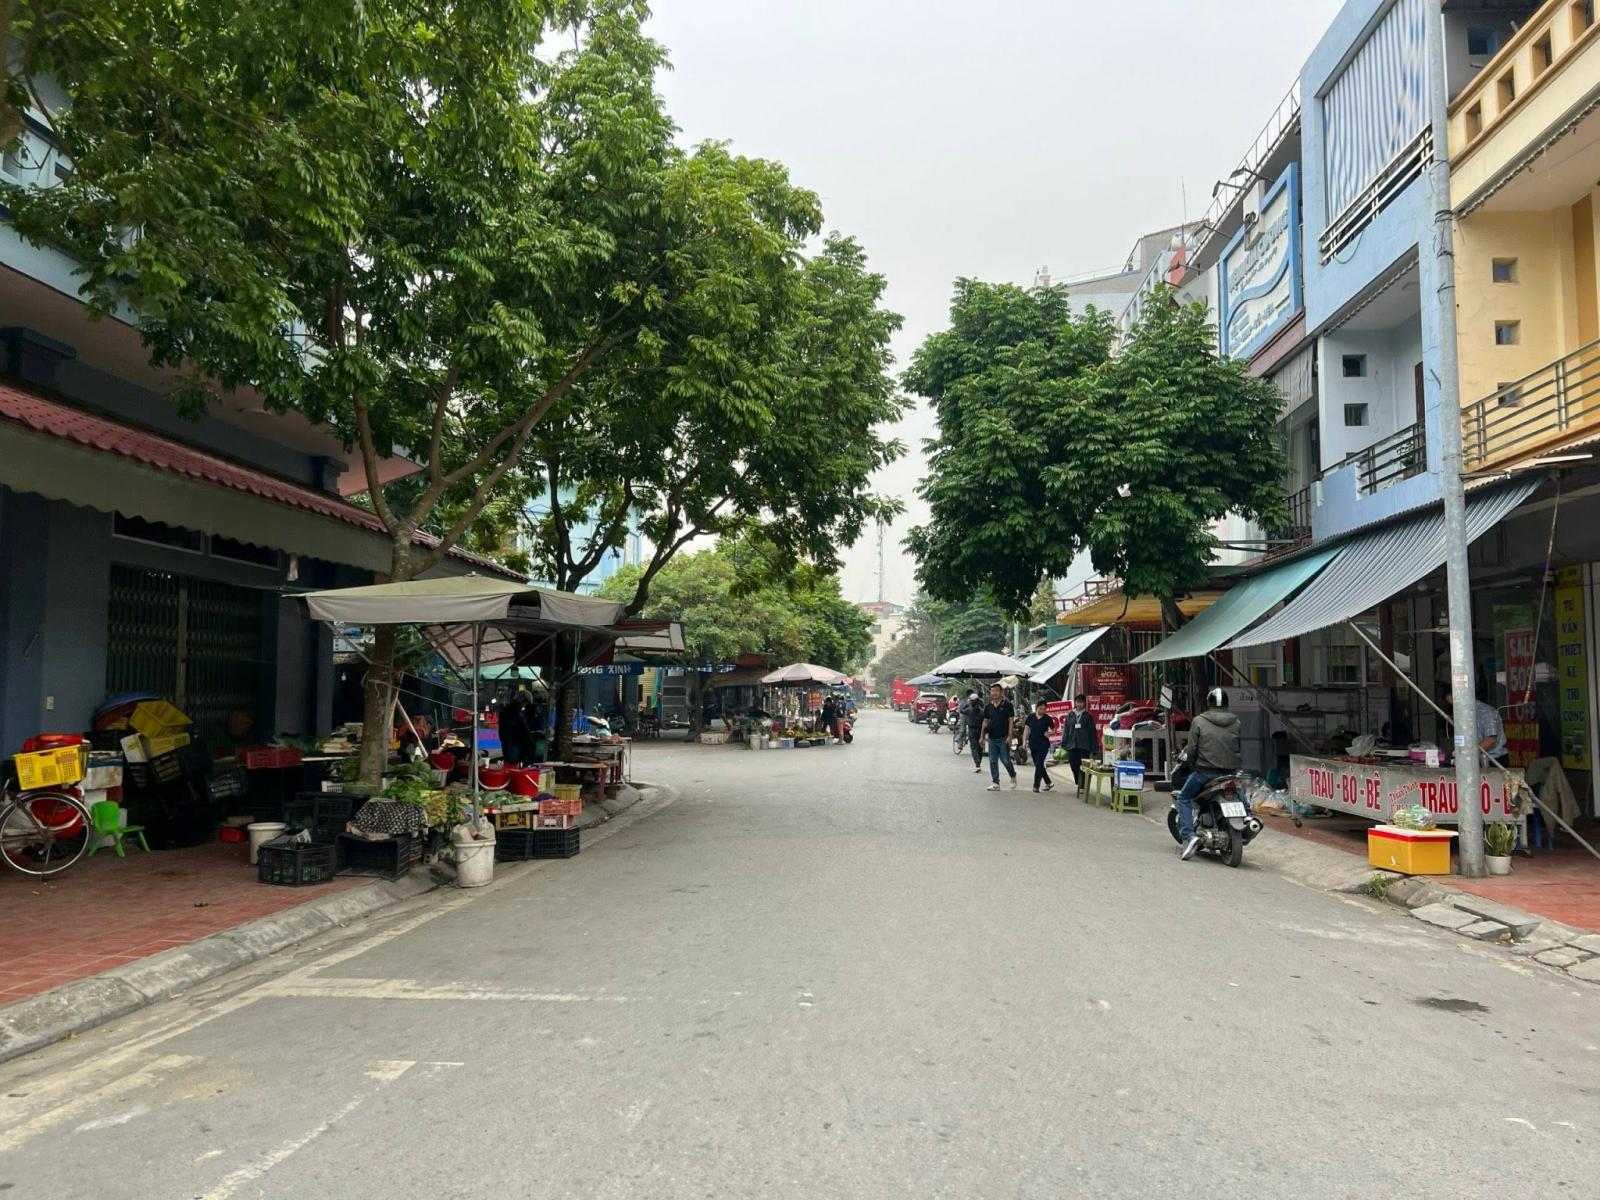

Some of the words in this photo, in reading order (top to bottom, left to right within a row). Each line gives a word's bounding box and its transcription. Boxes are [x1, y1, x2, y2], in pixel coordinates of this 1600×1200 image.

[1308, 763, 1335, 800] TRÂU
[1366, 771, 1382, 811] BÊ
[1419, 775, 1458, 815] TRÂU
